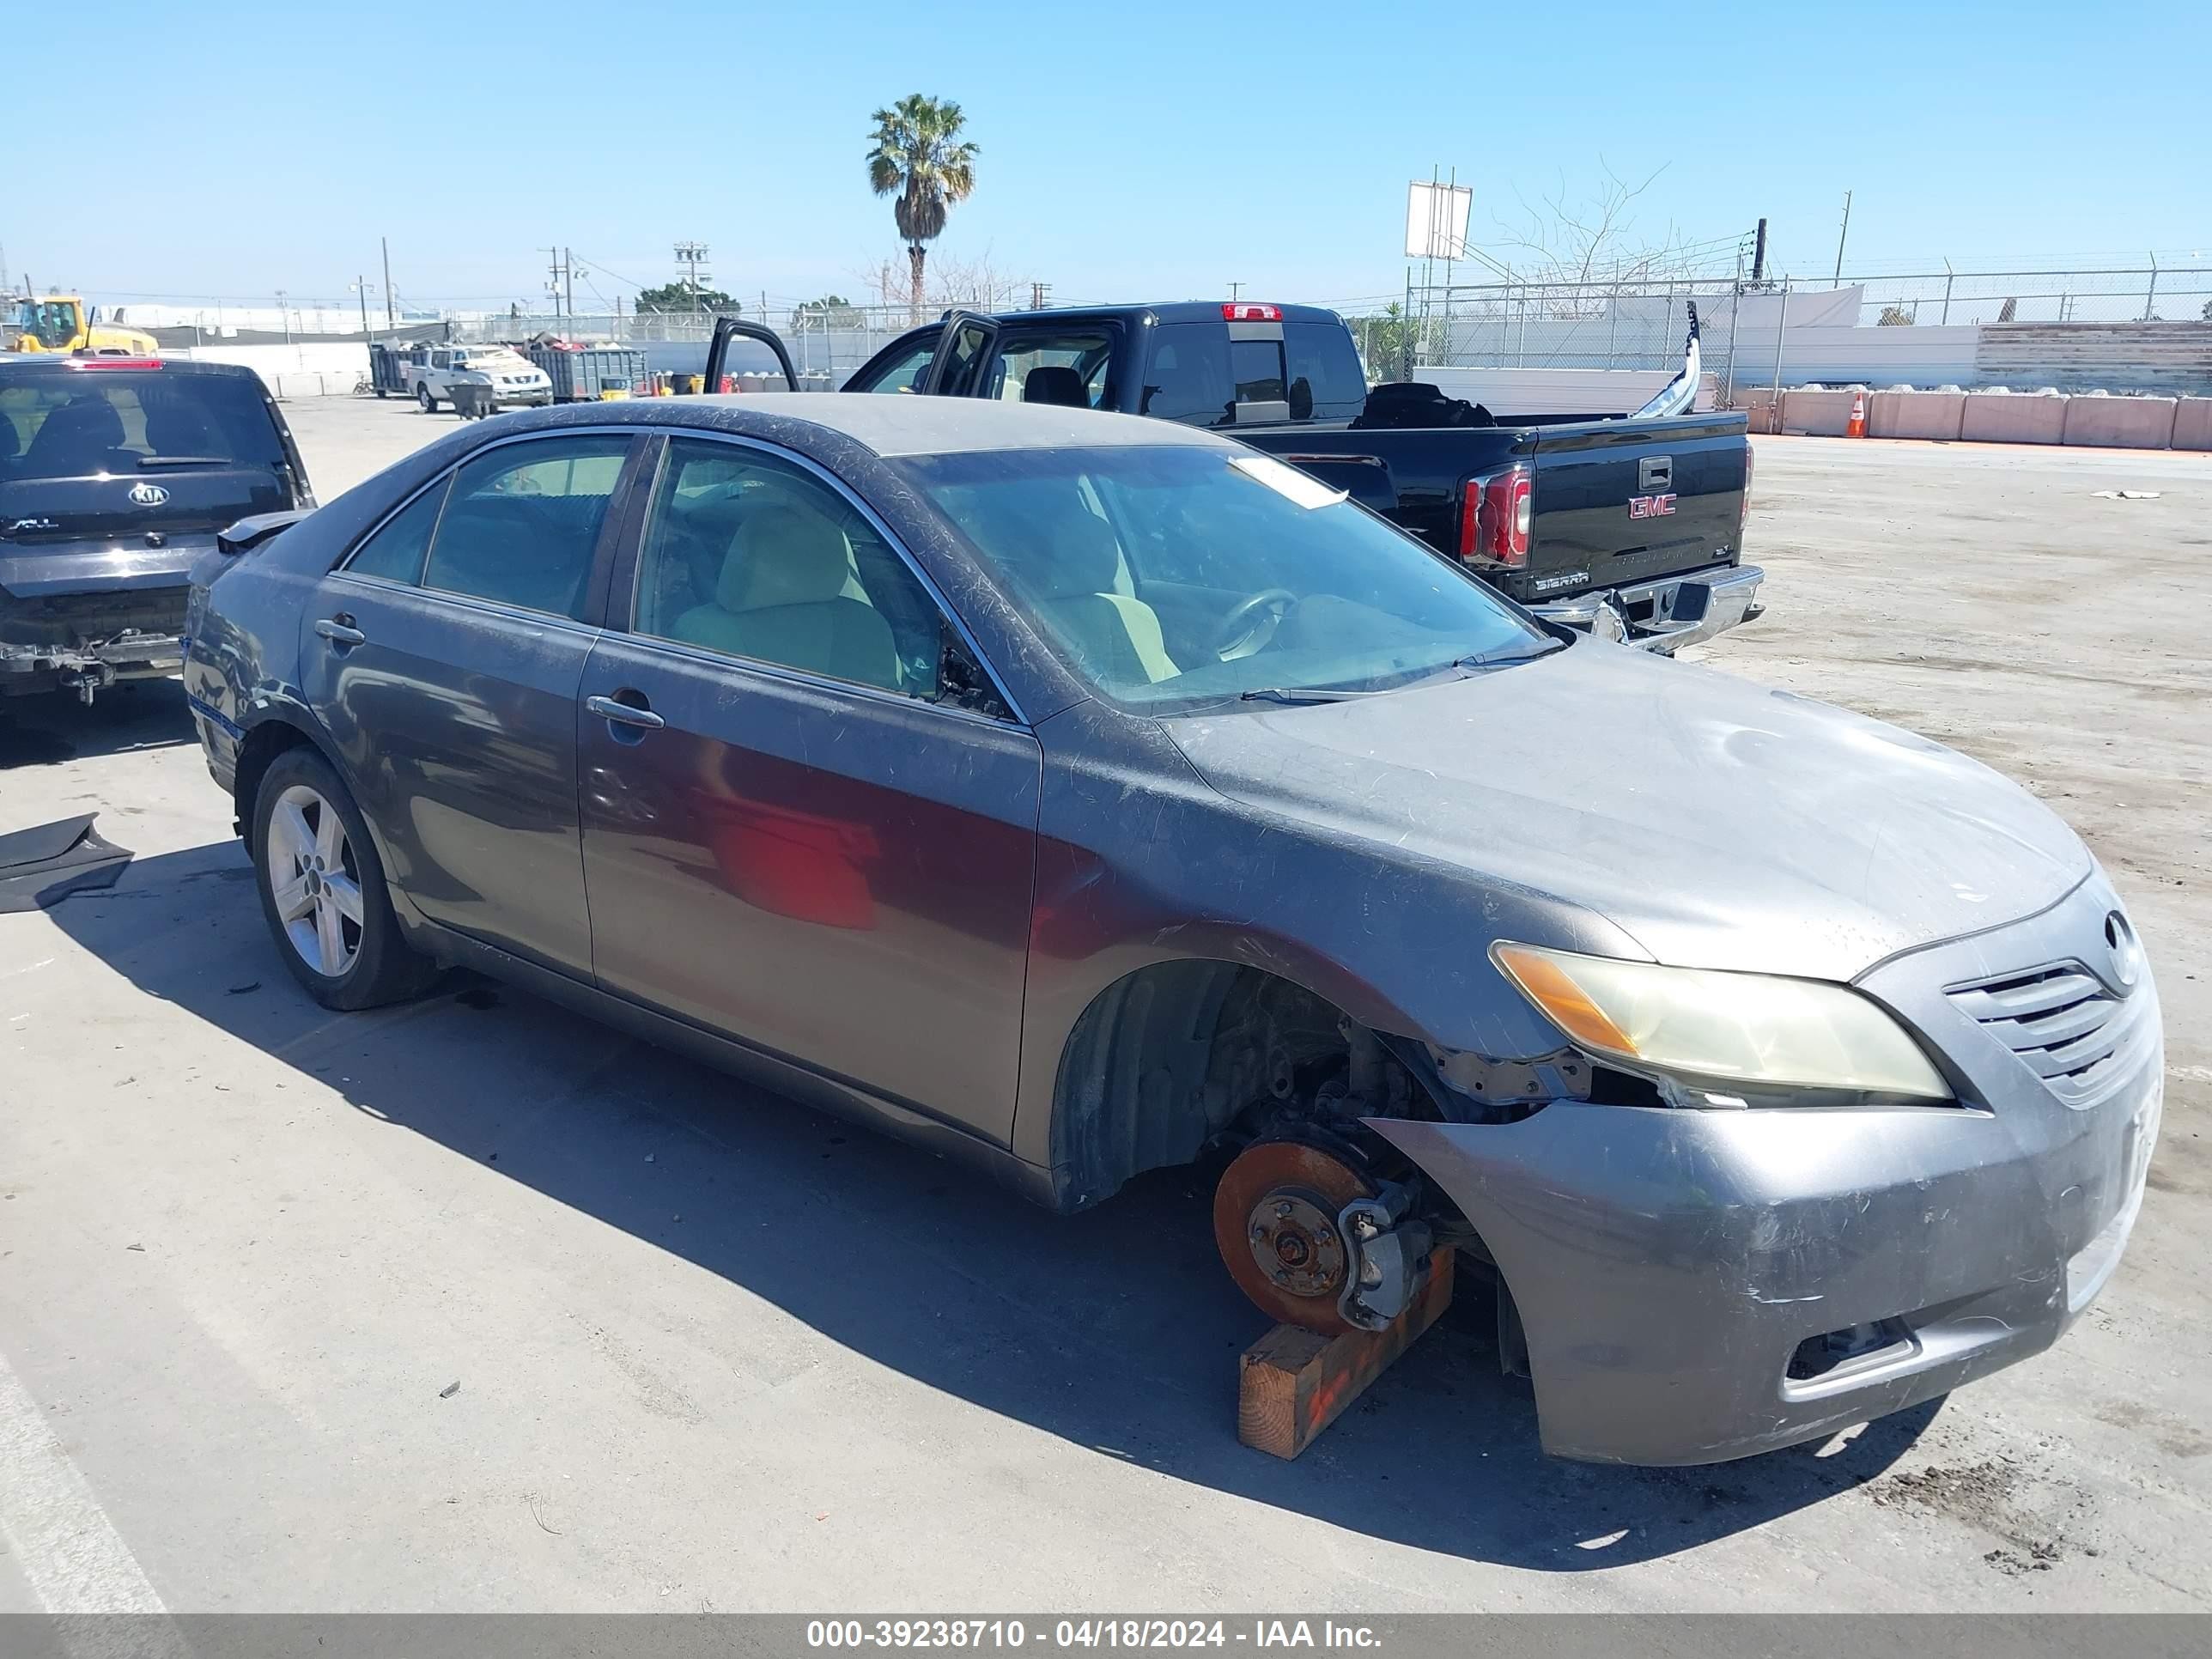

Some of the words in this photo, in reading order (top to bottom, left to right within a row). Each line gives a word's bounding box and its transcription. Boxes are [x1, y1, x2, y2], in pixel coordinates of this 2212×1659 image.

[135, 488, 165, 502] KIA
[1629, 494, 1677, 520] GMC
[1535, 572, 1589, 591] SIERRA
